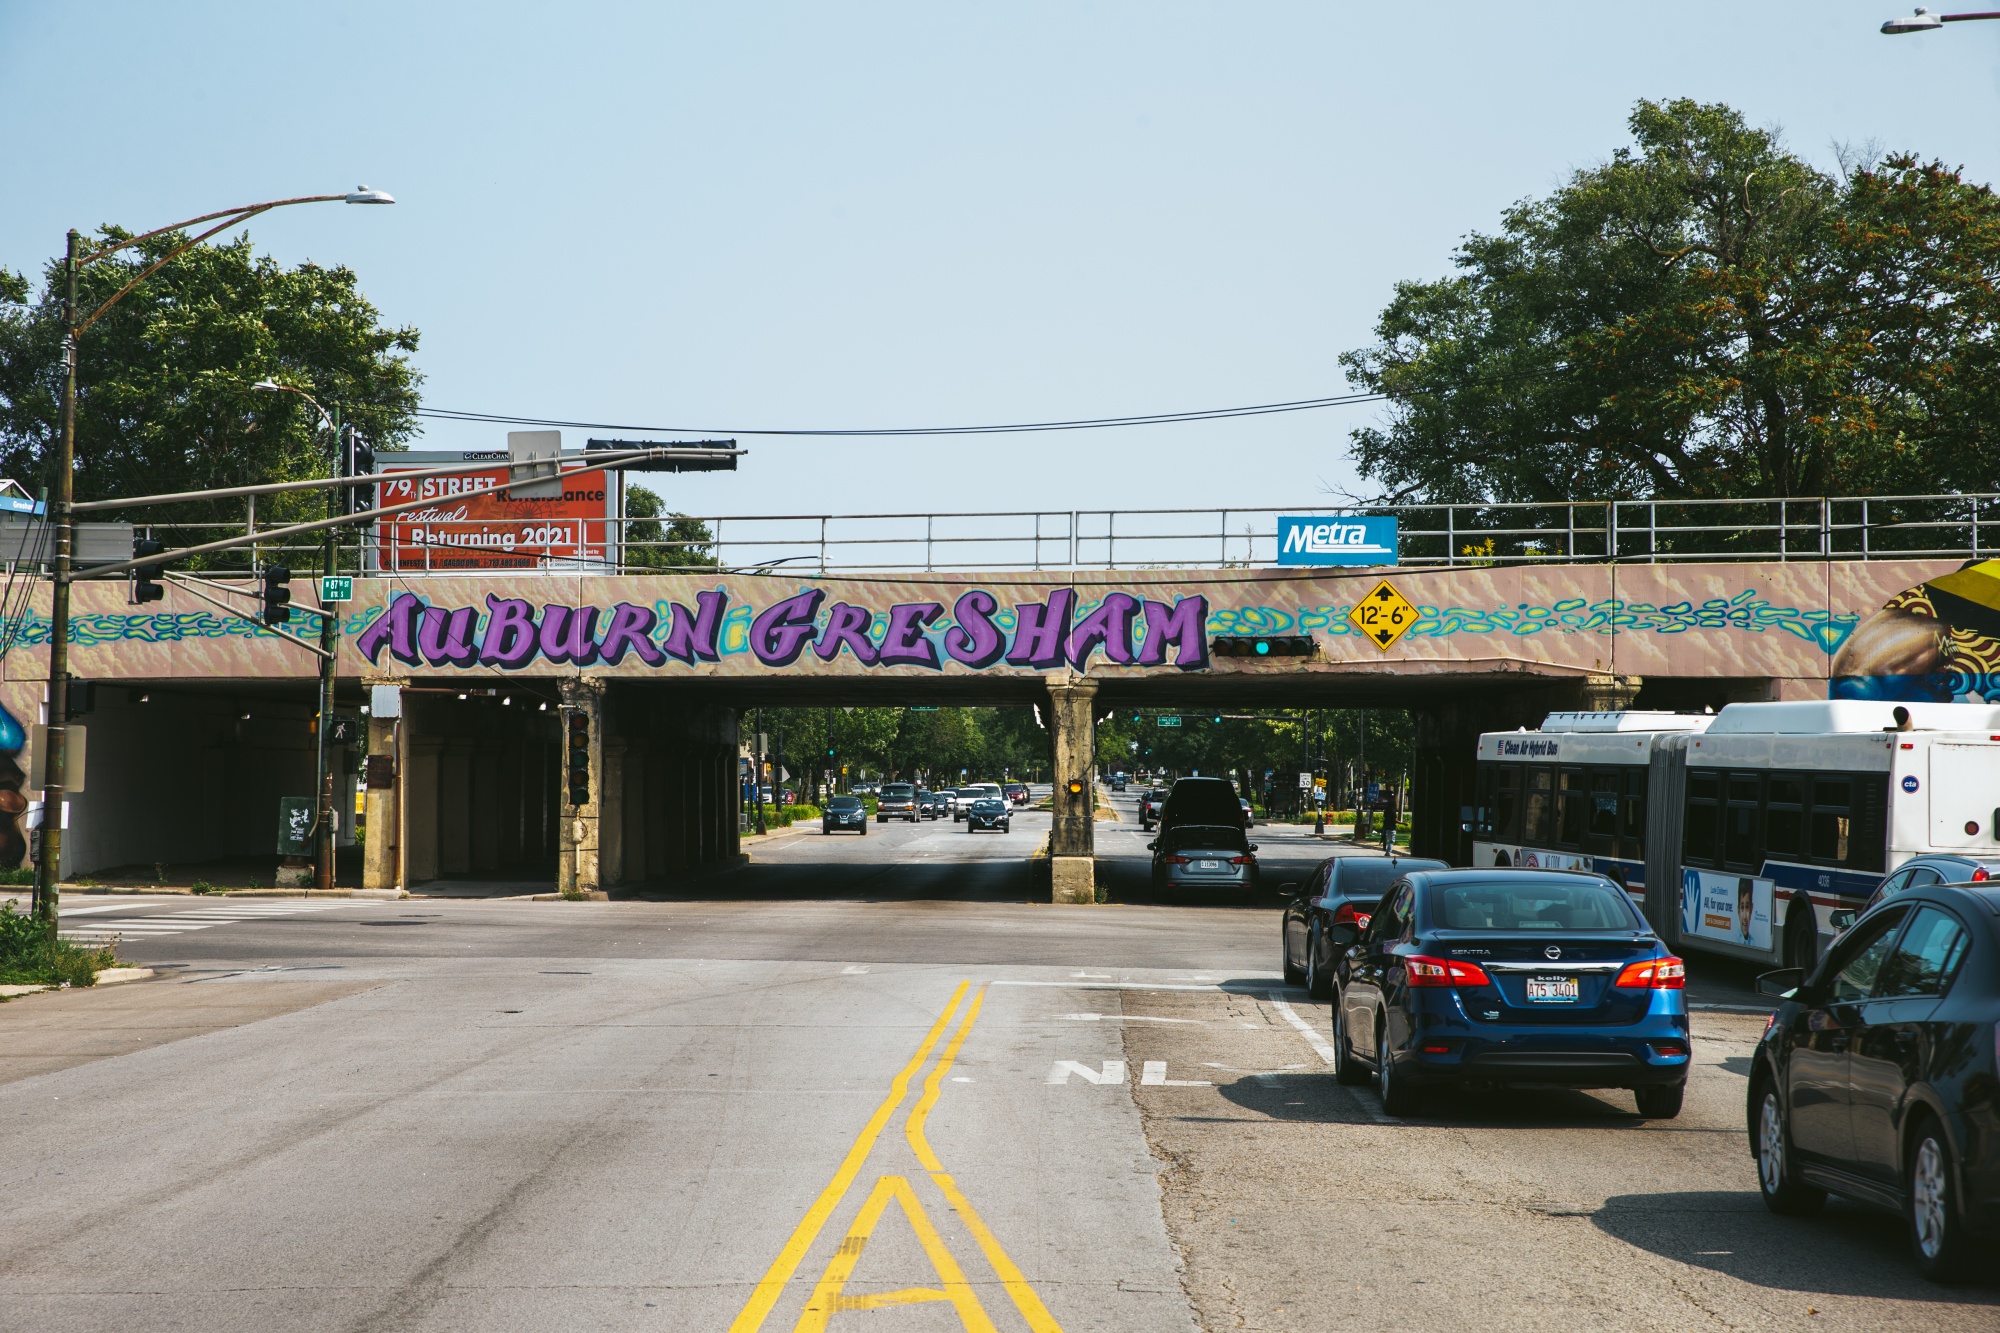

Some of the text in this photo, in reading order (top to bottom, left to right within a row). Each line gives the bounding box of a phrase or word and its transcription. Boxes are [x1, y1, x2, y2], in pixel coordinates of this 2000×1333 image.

[423, 477, 497, 496] STREET
[411, 527, 571, 552] Returning 2021
[1283, 522, 1376, 554] Metra
[1359, 605, 1409, 625] 12'-6"
[356, 587, 1210, 673] AUBURN GRESHAM
[1504, 740, 1558, 758] Clean Air Hybrid Bus
[1904, 780, 1917, 788] cta
[1817, 874, 1830, 887] 4036
[1716, 901, 1725, 913] your
[1528, 984, 1577, 997] A75 3401
